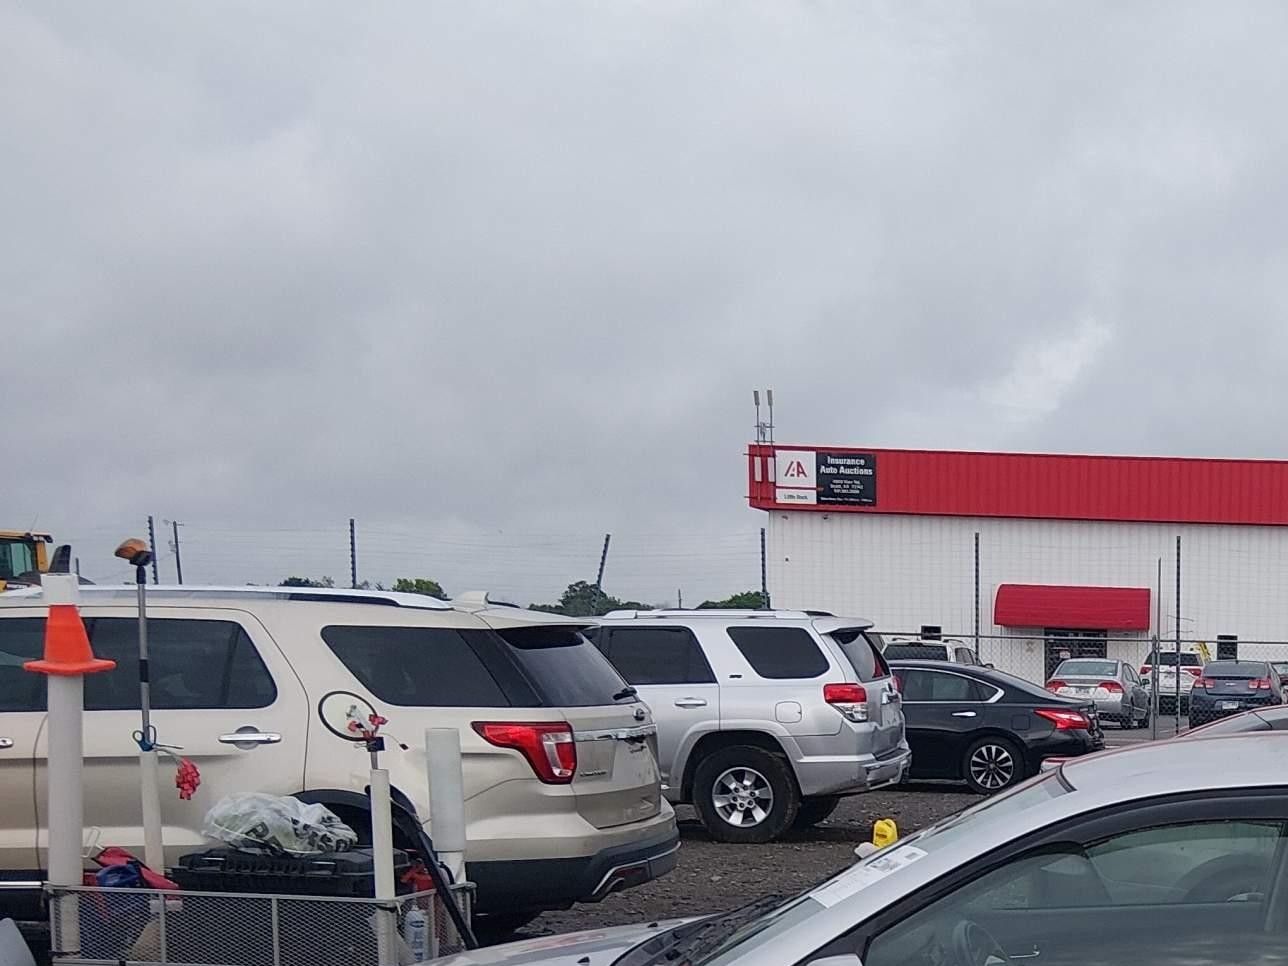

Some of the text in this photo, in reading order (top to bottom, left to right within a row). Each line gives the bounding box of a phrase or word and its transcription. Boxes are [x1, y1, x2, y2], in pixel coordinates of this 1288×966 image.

[827, 455, 865, 466] Insurance
[820, 465, 873, 476] Auto Auctions
